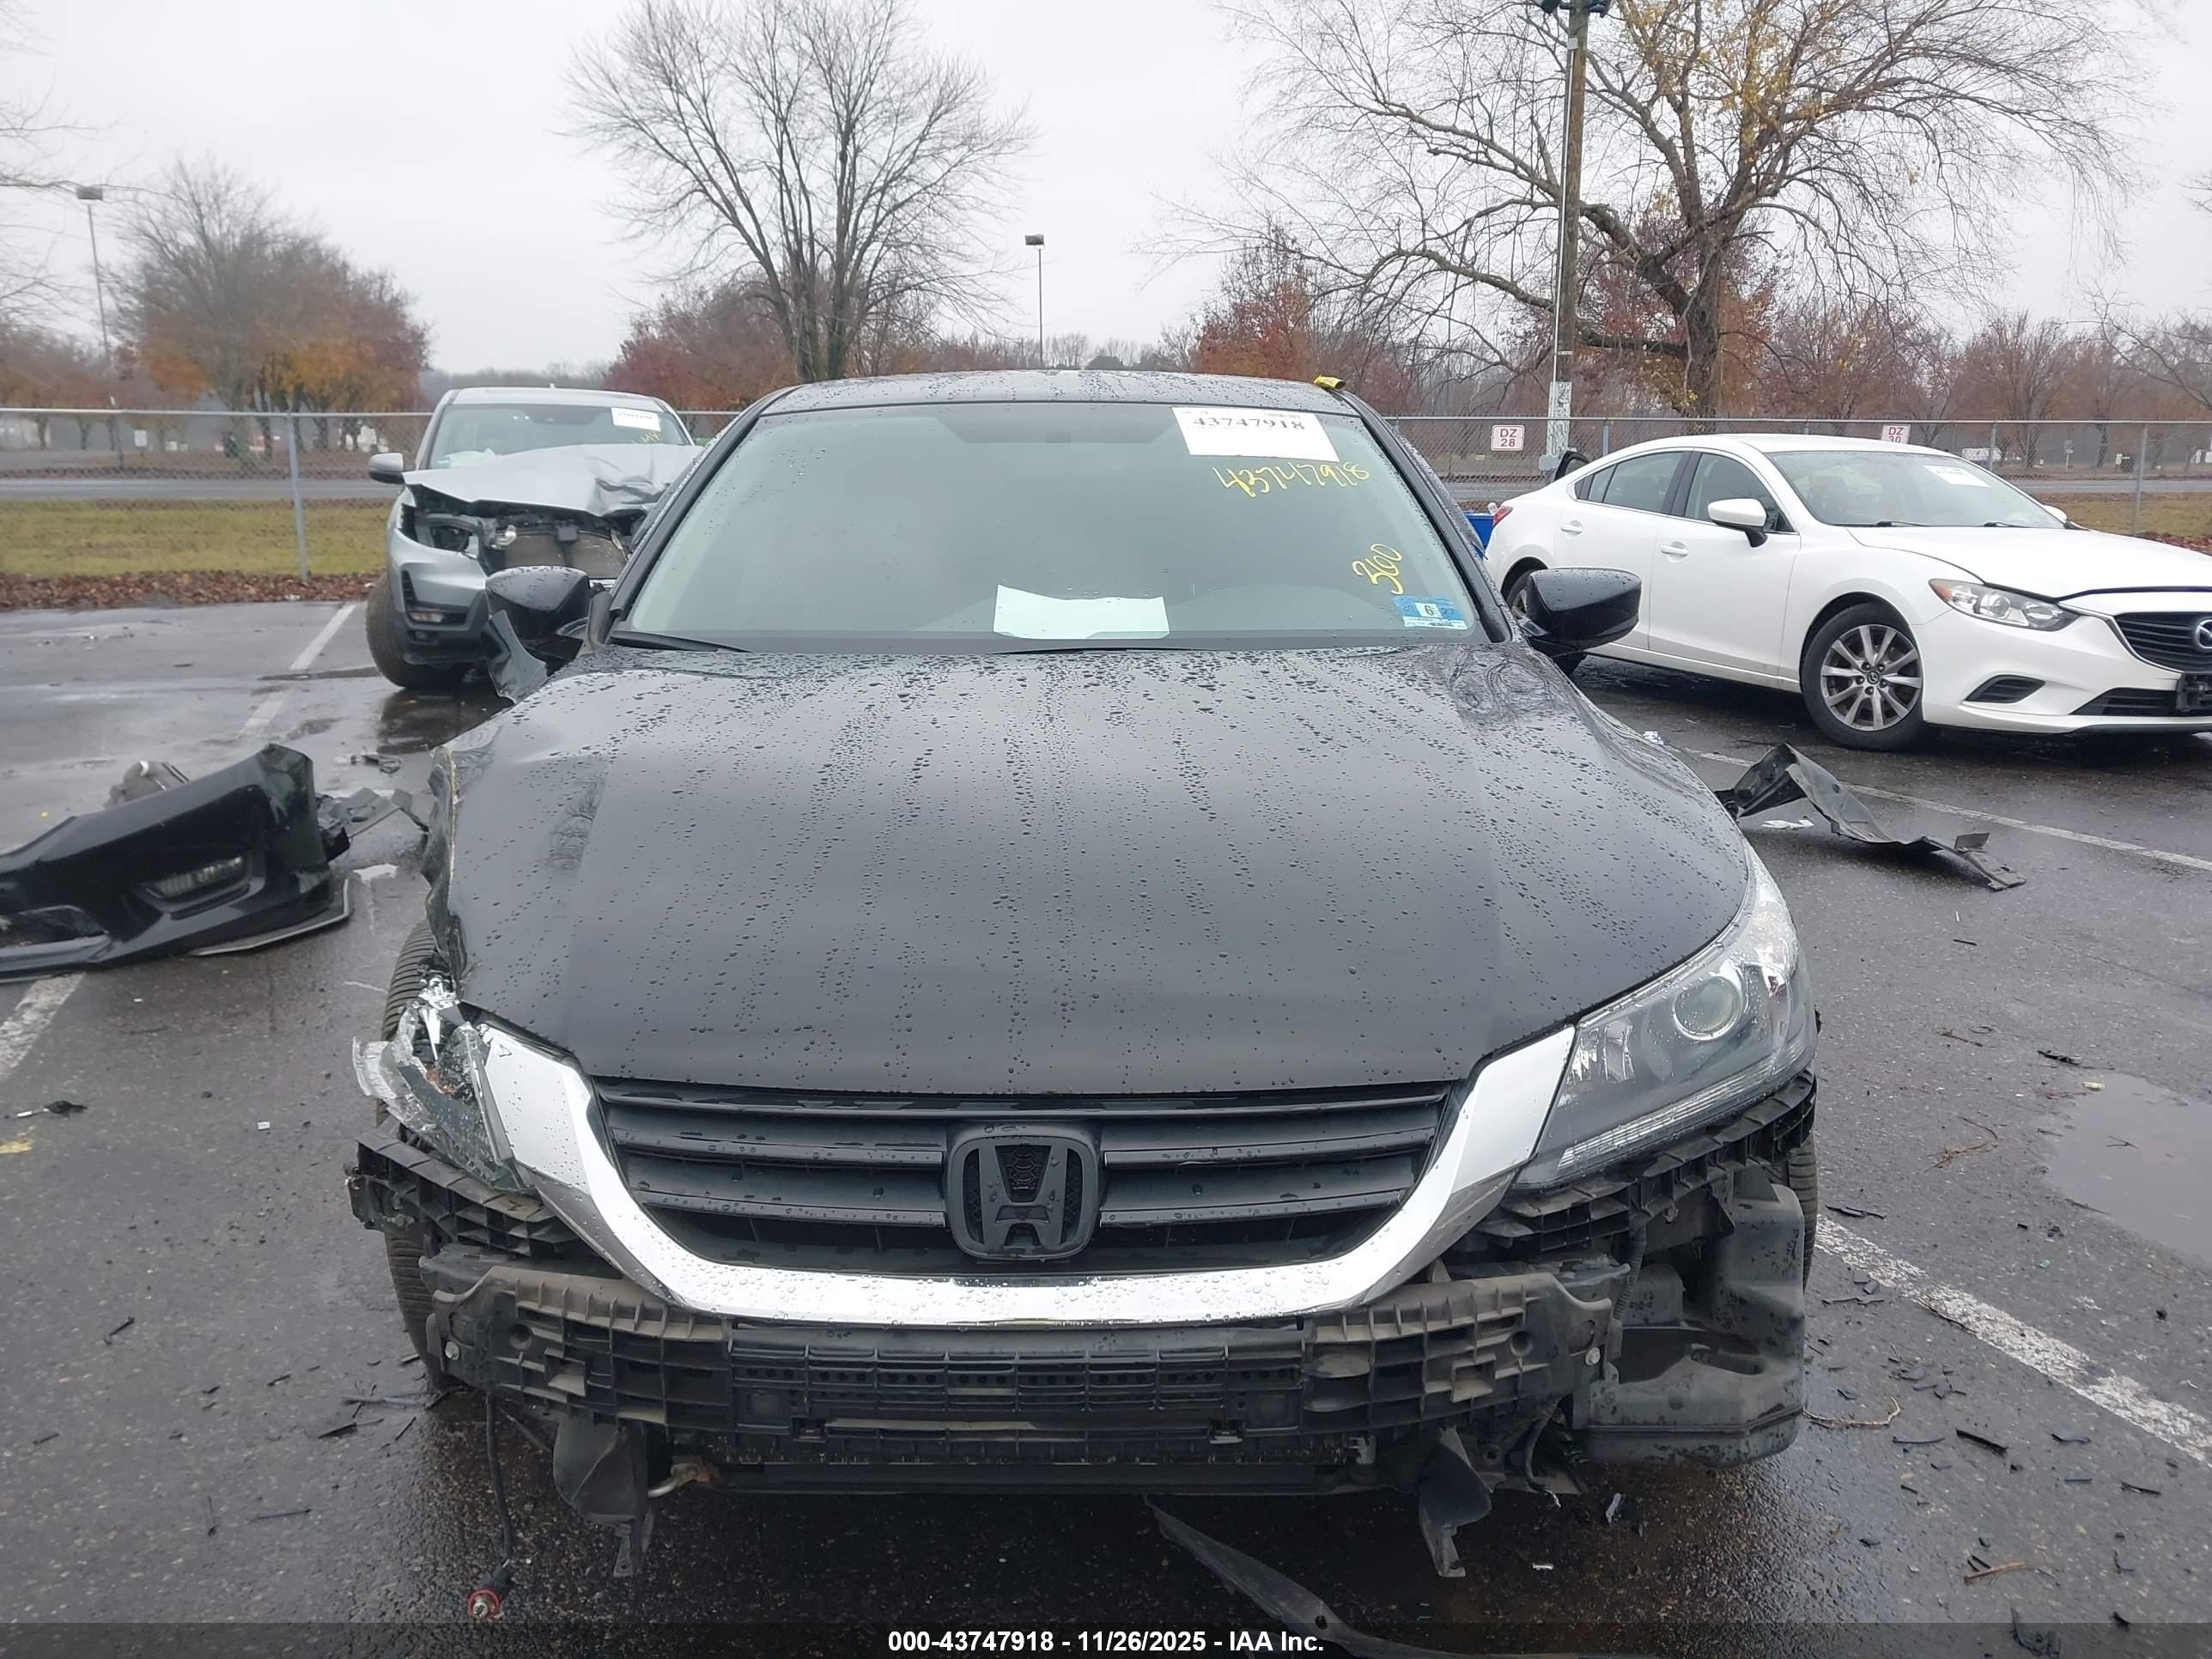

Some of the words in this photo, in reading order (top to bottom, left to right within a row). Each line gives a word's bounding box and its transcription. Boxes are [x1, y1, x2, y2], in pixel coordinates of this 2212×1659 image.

[1193, 417, 1305, 430] 43747918
[1500, 428, 1517, 437] DZ
[1888, 427, 1904, 435] DZ
[1500, 438, 1516, 447] 28
[1212, 461, 1370, 497] 43747918
[1424, 605, 1434, 616] 6
